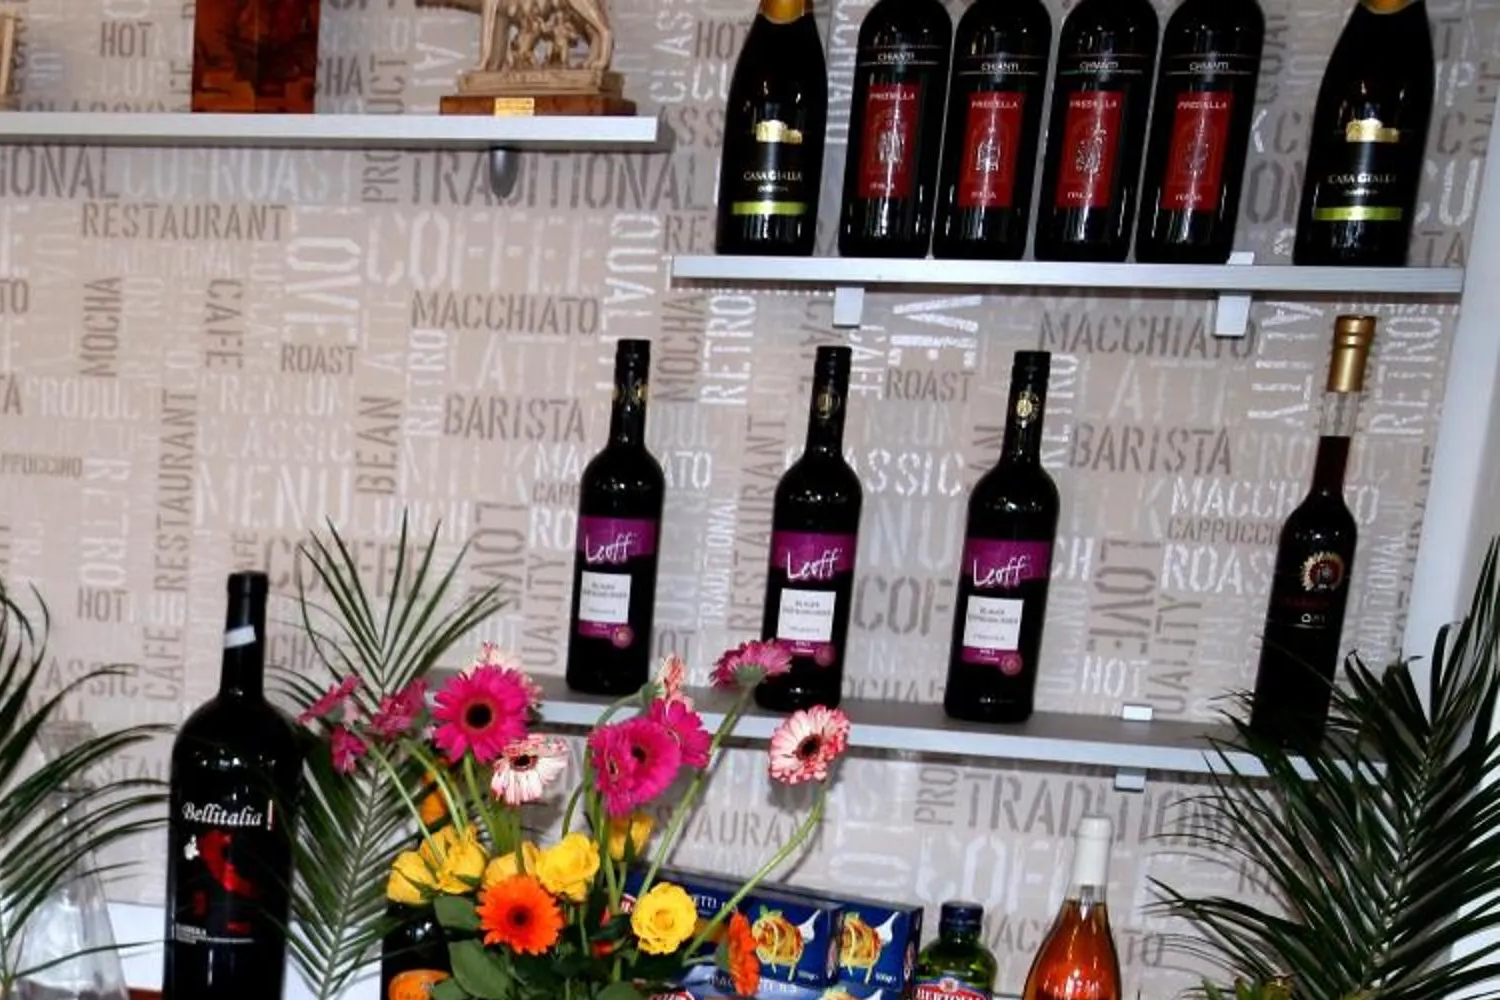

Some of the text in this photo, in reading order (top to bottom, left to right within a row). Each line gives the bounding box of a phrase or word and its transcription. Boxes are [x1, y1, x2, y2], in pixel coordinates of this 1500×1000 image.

[100, 22, 152, 59] HOT
[81, 202, 287, 241] RESTAURANT
[80, 275, 123, 379] MOCHA
[411, 289, 599, 336] MACCHIATO
[280, 342, 359, 375] ROAST
[653, 296, 705, 403] MOCHA
[700, 294, 758, 407] RETRO
[1245, 302, 1324, 428] ALITY
[1367, 316, 1442, 436] RETRO
[401, 328, 448, 438] RETRO
[884, 365, 976, 403] ROAST
[355, 395, 403, 496] BEAN
[442, 391, 587, 444] BARISTA
[864, 447, 966, 498] SSIC
[1067, 422, 1234, 477] BARISTA
[152, 387, 198, 592] RESTAURANT
[193, 460, 353, 531] MENU
[1170, 475, 1380, 526] MACCHO
[726, 414, 787, 632] RESTAURANT
[1165, 517, 1280, 546] CAPPUCCI
[1085, 537, 1161, 657] LOVE
[1160, 544, 1274, 598] ROAS
[1360, 533, 1406, 662] RADITIONAL
[77, 586, 129, 624] HOT
[521, 553, 567, 667] UALITY
[44, 656, 140, 698] ASSIC
[142, 626, 185, 703] CAFE
[657, 627, 697, 664] OT
[1139, 592, 1203, 715] UALITY
[182, 801, 263, 827] Bellitalia
